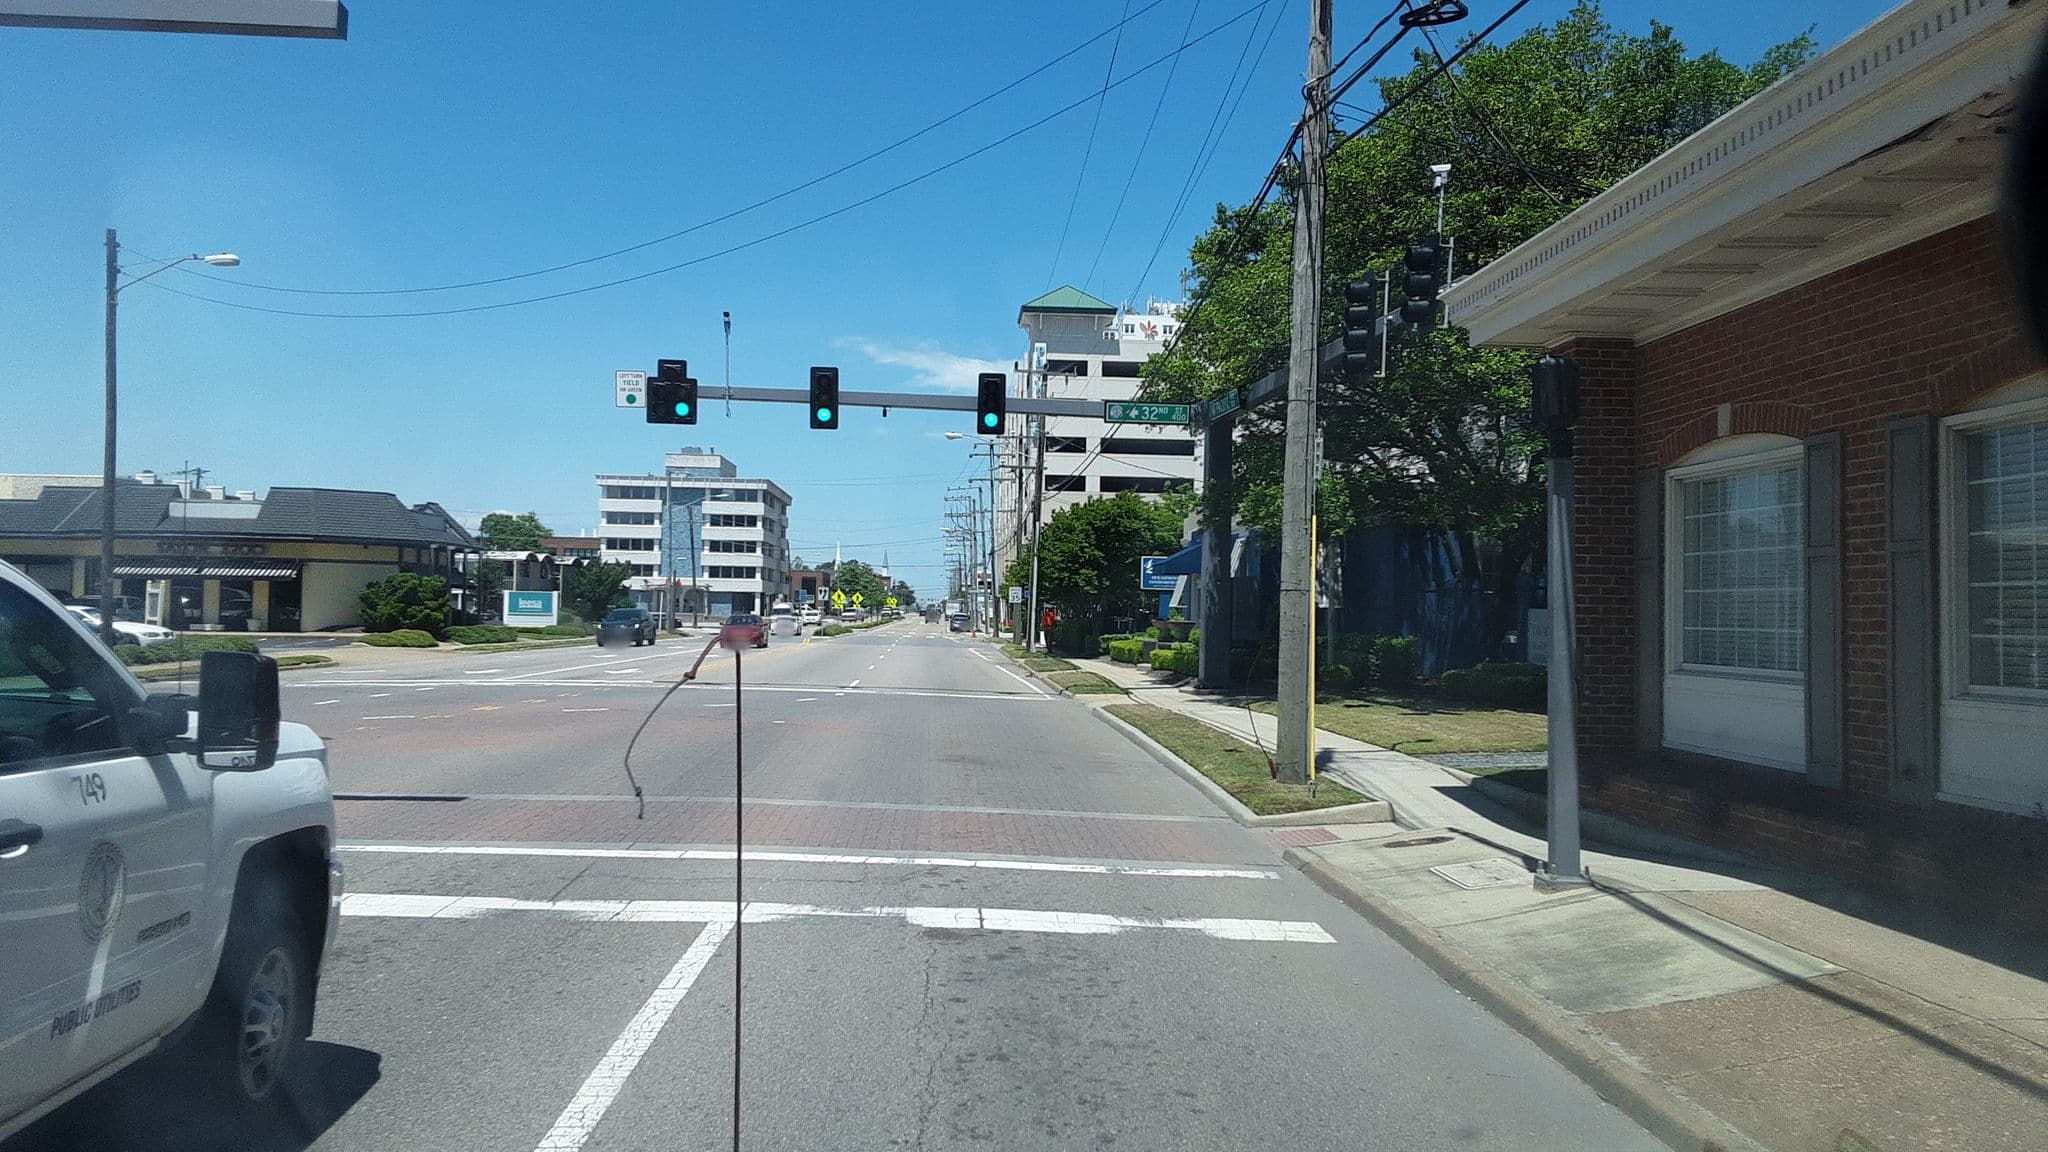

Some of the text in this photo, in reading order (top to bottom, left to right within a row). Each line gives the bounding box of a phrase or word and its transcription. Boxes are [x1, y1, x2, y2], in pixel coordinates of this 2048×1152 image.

[1141, 406, 1168, 420] 32ND
[1171, 413, 1186, 421] 400
[71, 773, 106, 806] 749
[50, 979, 142, 1041] PUBLIC UTILITIES
